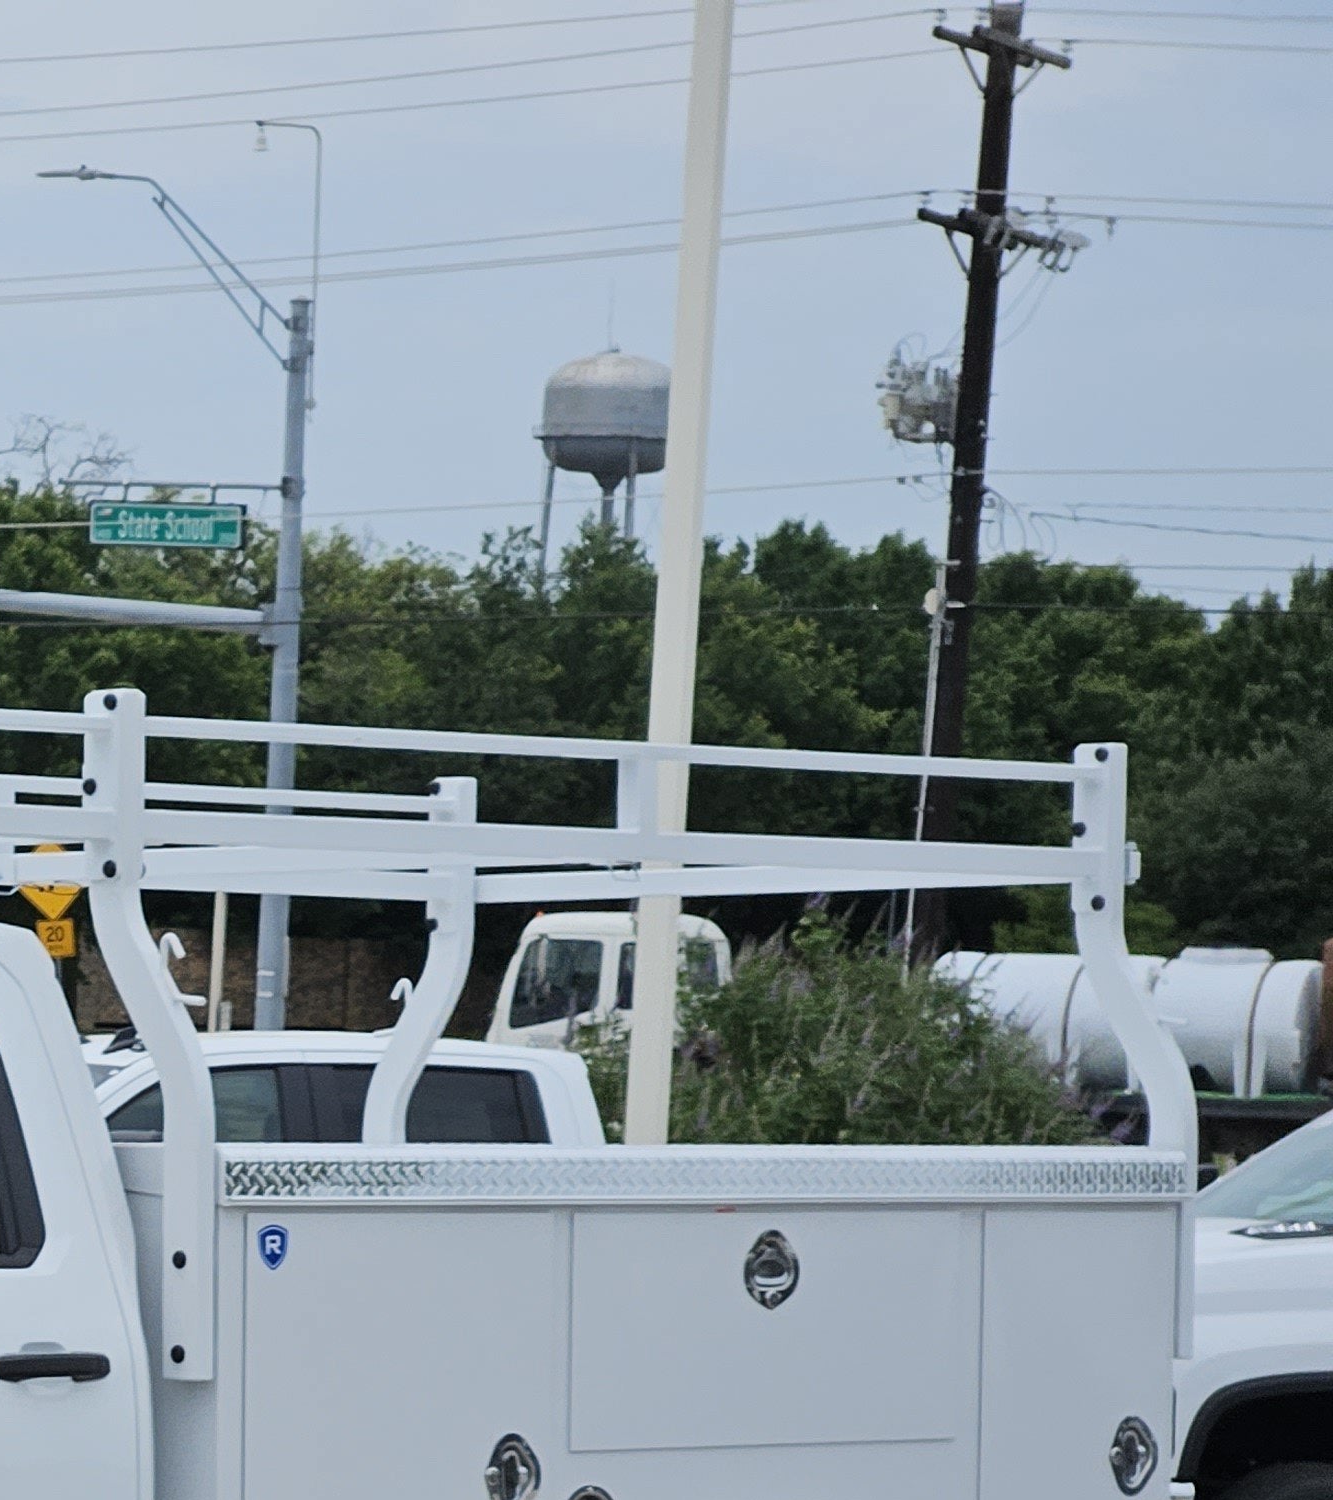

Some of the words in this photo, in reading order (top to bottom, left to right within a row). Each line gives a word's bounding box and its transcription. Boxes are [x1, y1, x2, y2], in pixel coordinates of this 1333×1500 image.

[118, 510, 159, 540] State
[164, 510, 214, 541] School
[45, 926, 65, 942] 20
[264, 1235, 282, 1255] R
